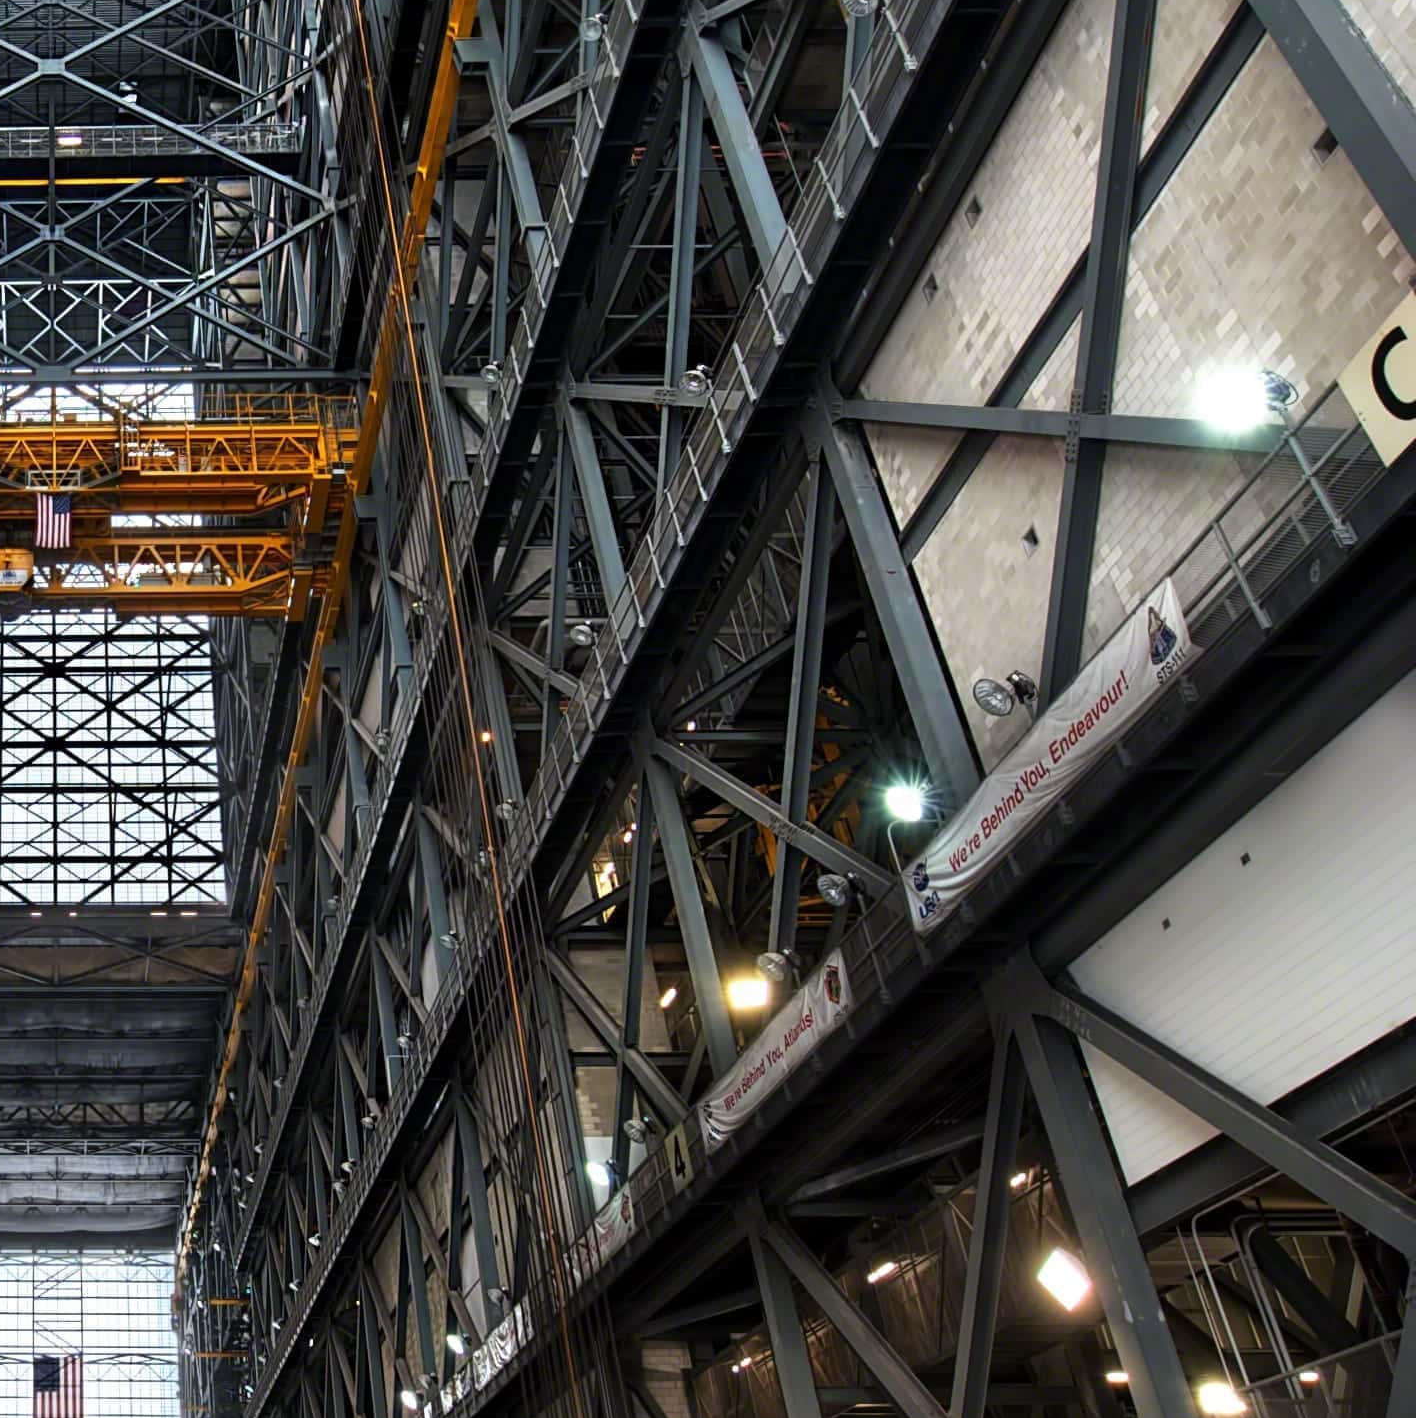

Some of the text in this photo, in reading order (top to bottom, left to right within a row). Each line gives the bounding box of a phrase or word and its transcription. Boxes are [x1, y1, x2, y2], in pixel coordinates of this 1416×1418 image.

[1156, 647, 1187, 685] STS-111
[948, 669, 1130, 873] We're Behind You, Endeavour!
[674, 1134, 687, 1177] 4
